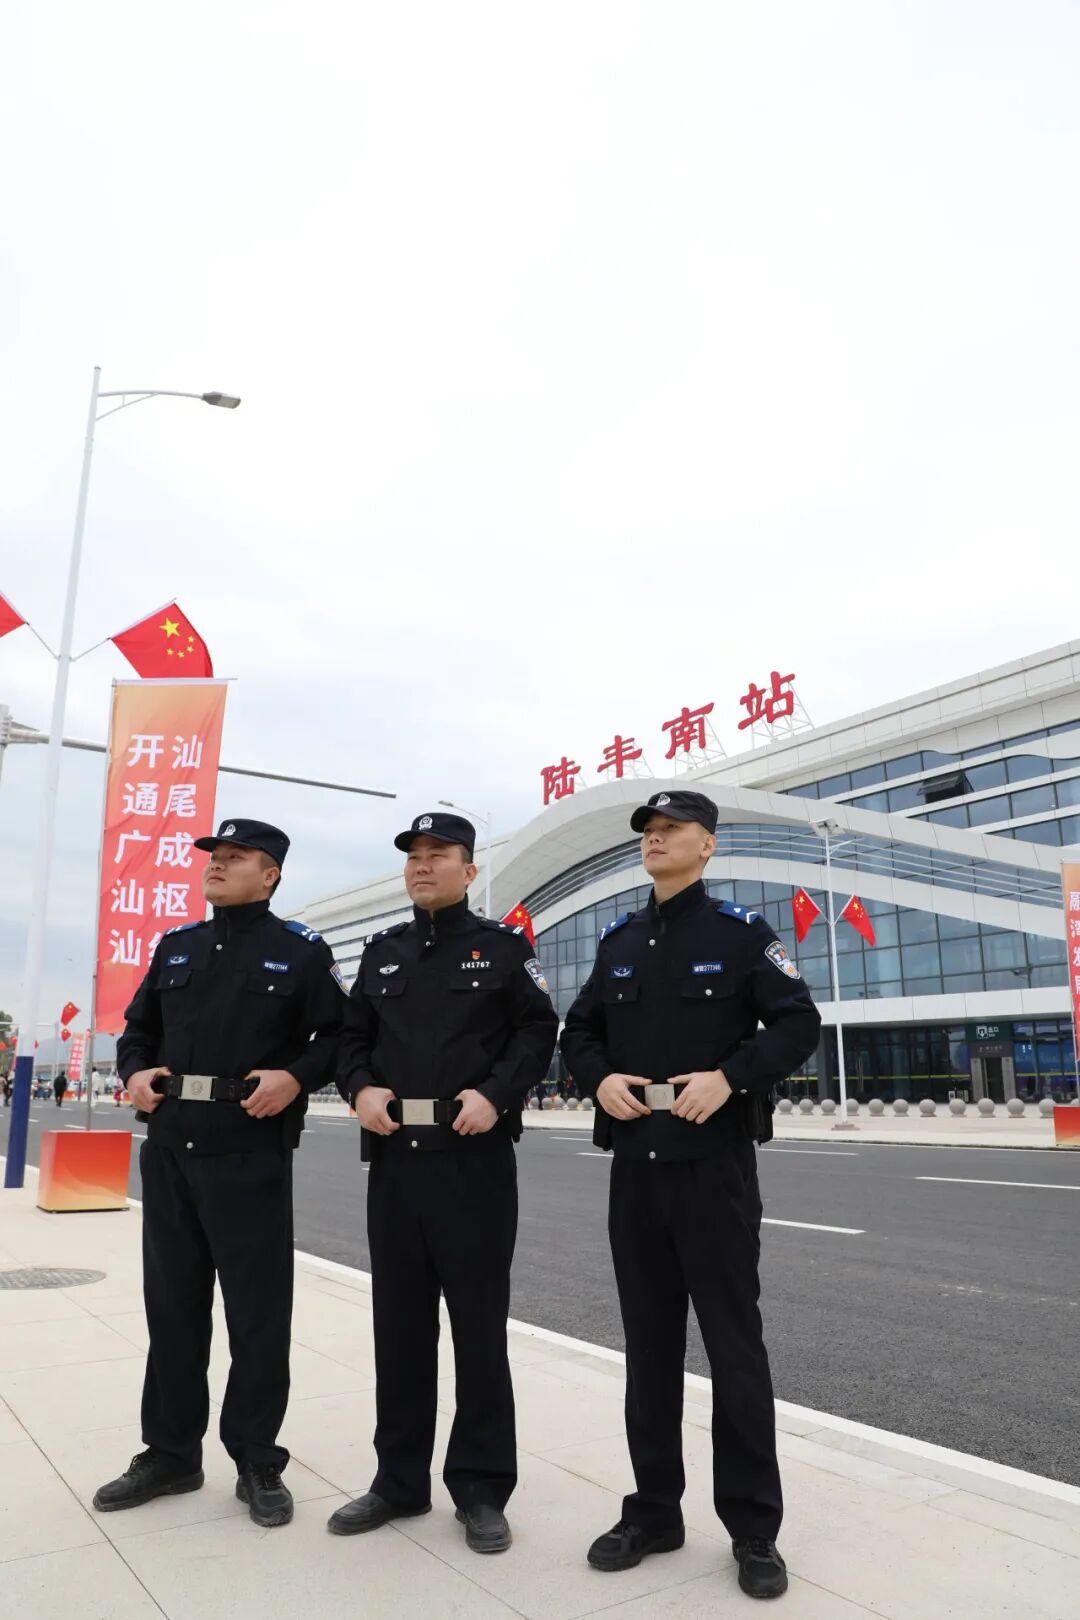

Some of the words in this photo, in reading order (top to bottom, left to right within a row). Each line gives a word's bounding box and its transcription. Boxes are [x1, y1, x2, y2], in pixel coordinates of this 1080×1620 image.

[108, 734, 165, 967] 开通广汕汕
[147, 734, 204, 967] 汕尾成枢
[540, 671, 796, 805] 陆丰南站
